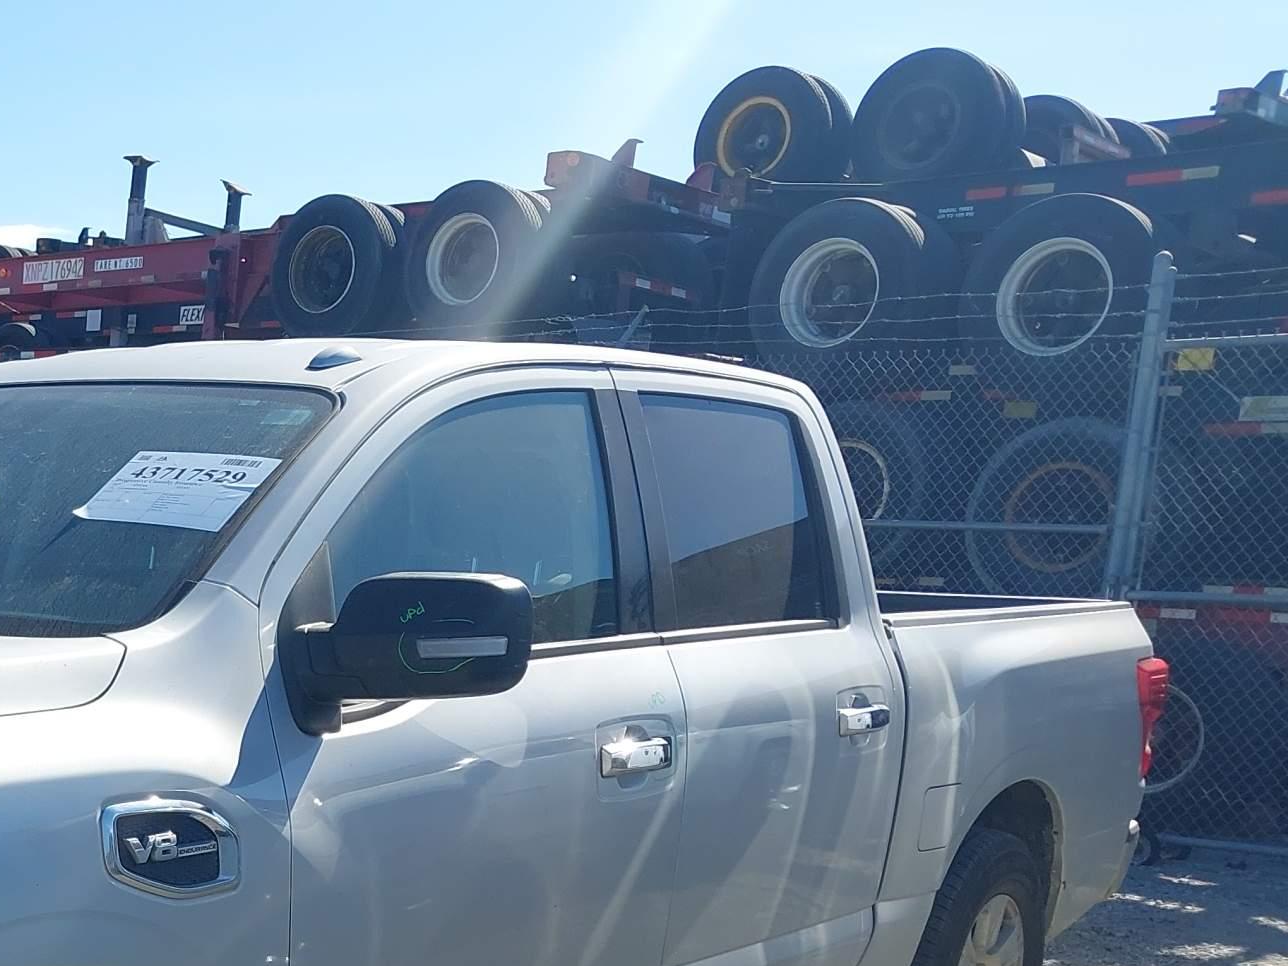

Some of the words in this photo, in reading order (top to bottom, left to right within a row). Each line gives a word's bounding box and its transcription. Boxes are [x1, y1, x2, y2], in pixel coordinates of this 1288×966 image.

[24, 260, 84, 282] XNPZ176942
[130, 465, 247, 484] 43717529
[123, 830, 178, 864] V8
